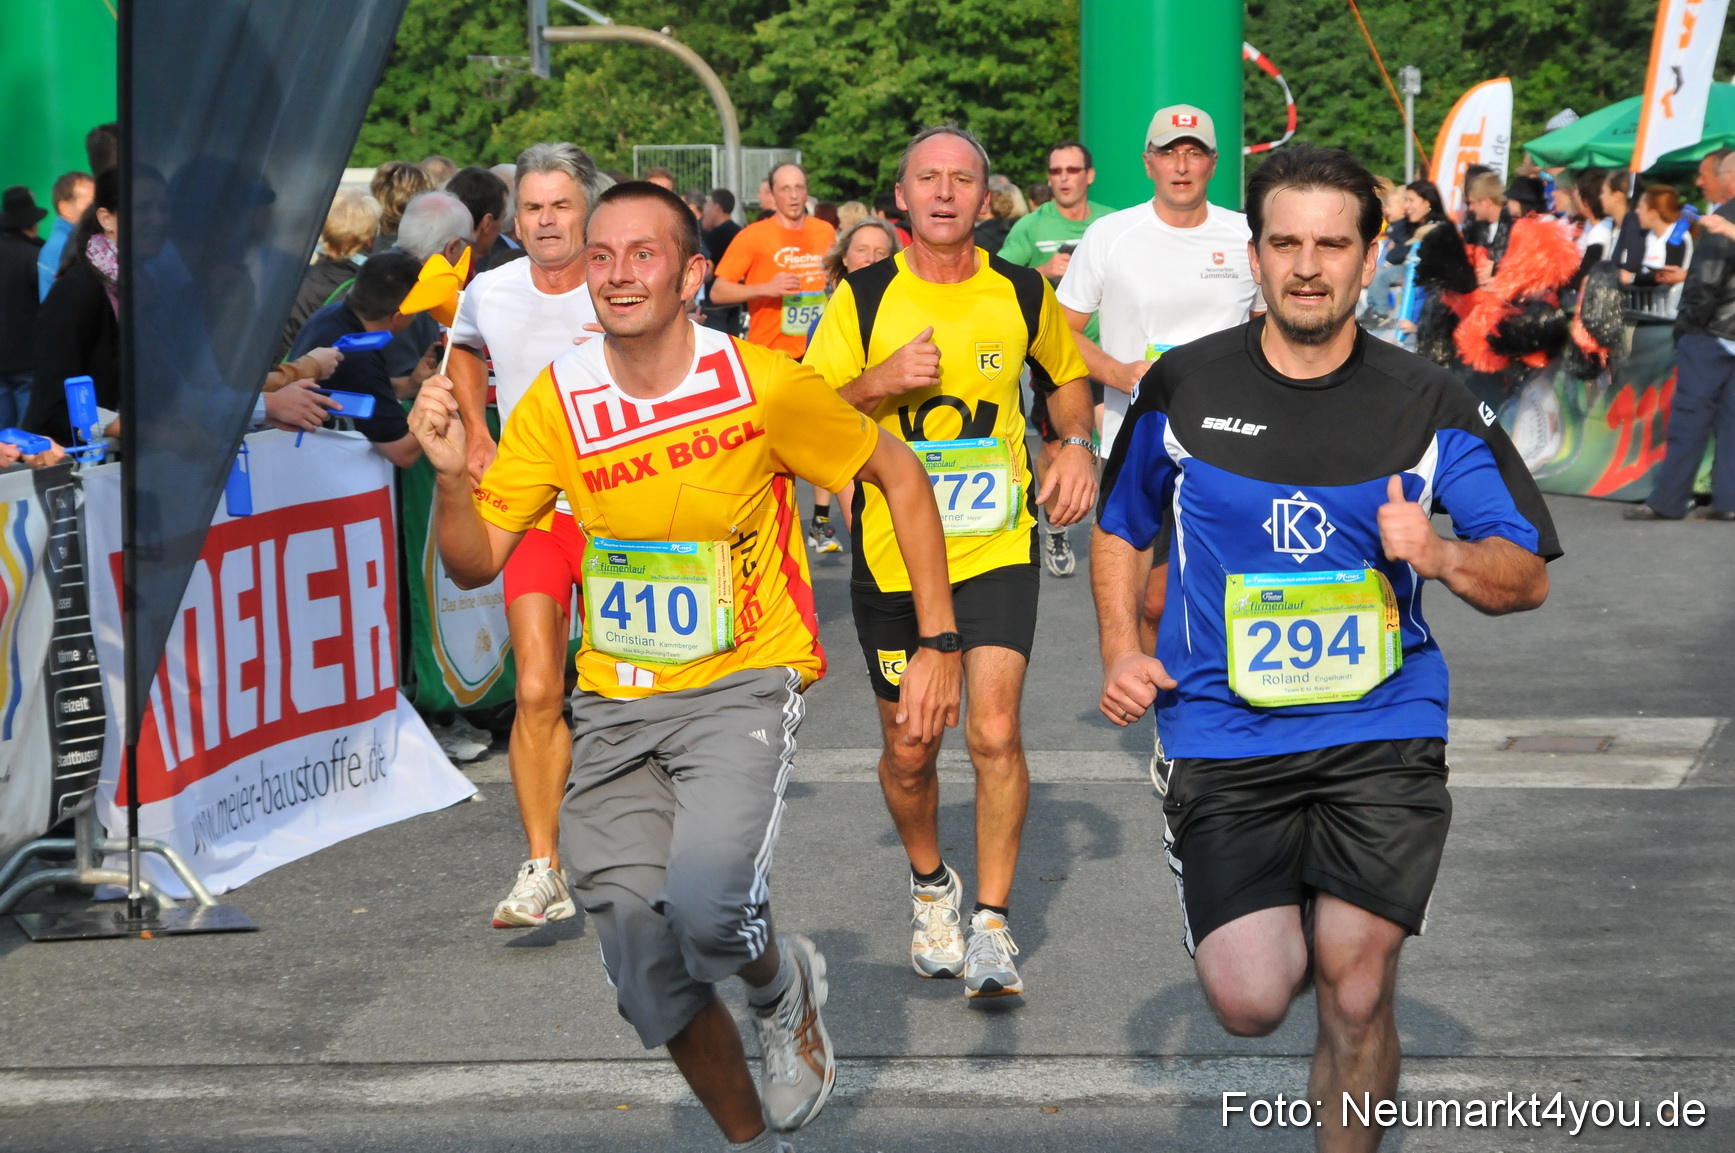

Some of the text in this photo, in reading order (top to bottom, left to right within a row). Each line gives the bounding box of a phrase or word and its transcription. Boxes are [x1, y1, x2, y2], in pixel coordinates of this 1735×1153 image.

[787, 306, 820, 324] 955
[980, 353, 1001, 369] FC
[1201, 416, 1267, 437] saller
[582, 420, 766, 493] MAX BÖGL
[600, 562, 646, 574] firmenlauf
[441, 598, 456, 612] Das
[600, 581, 699, 636] 410
[1250, 600, 1305, 612] firmenlauf
[149, 517, 396, 773] MEIER
[606, 631, 698, 650] Christian Kammberger
[1247, 615, 1366, 672] 294
[882, 661, 903, 675] FC
[1262, 673, 1353, 686] Roland Engelhardt
[193, 728, 387, 856] www.meier-baustoffe.de
